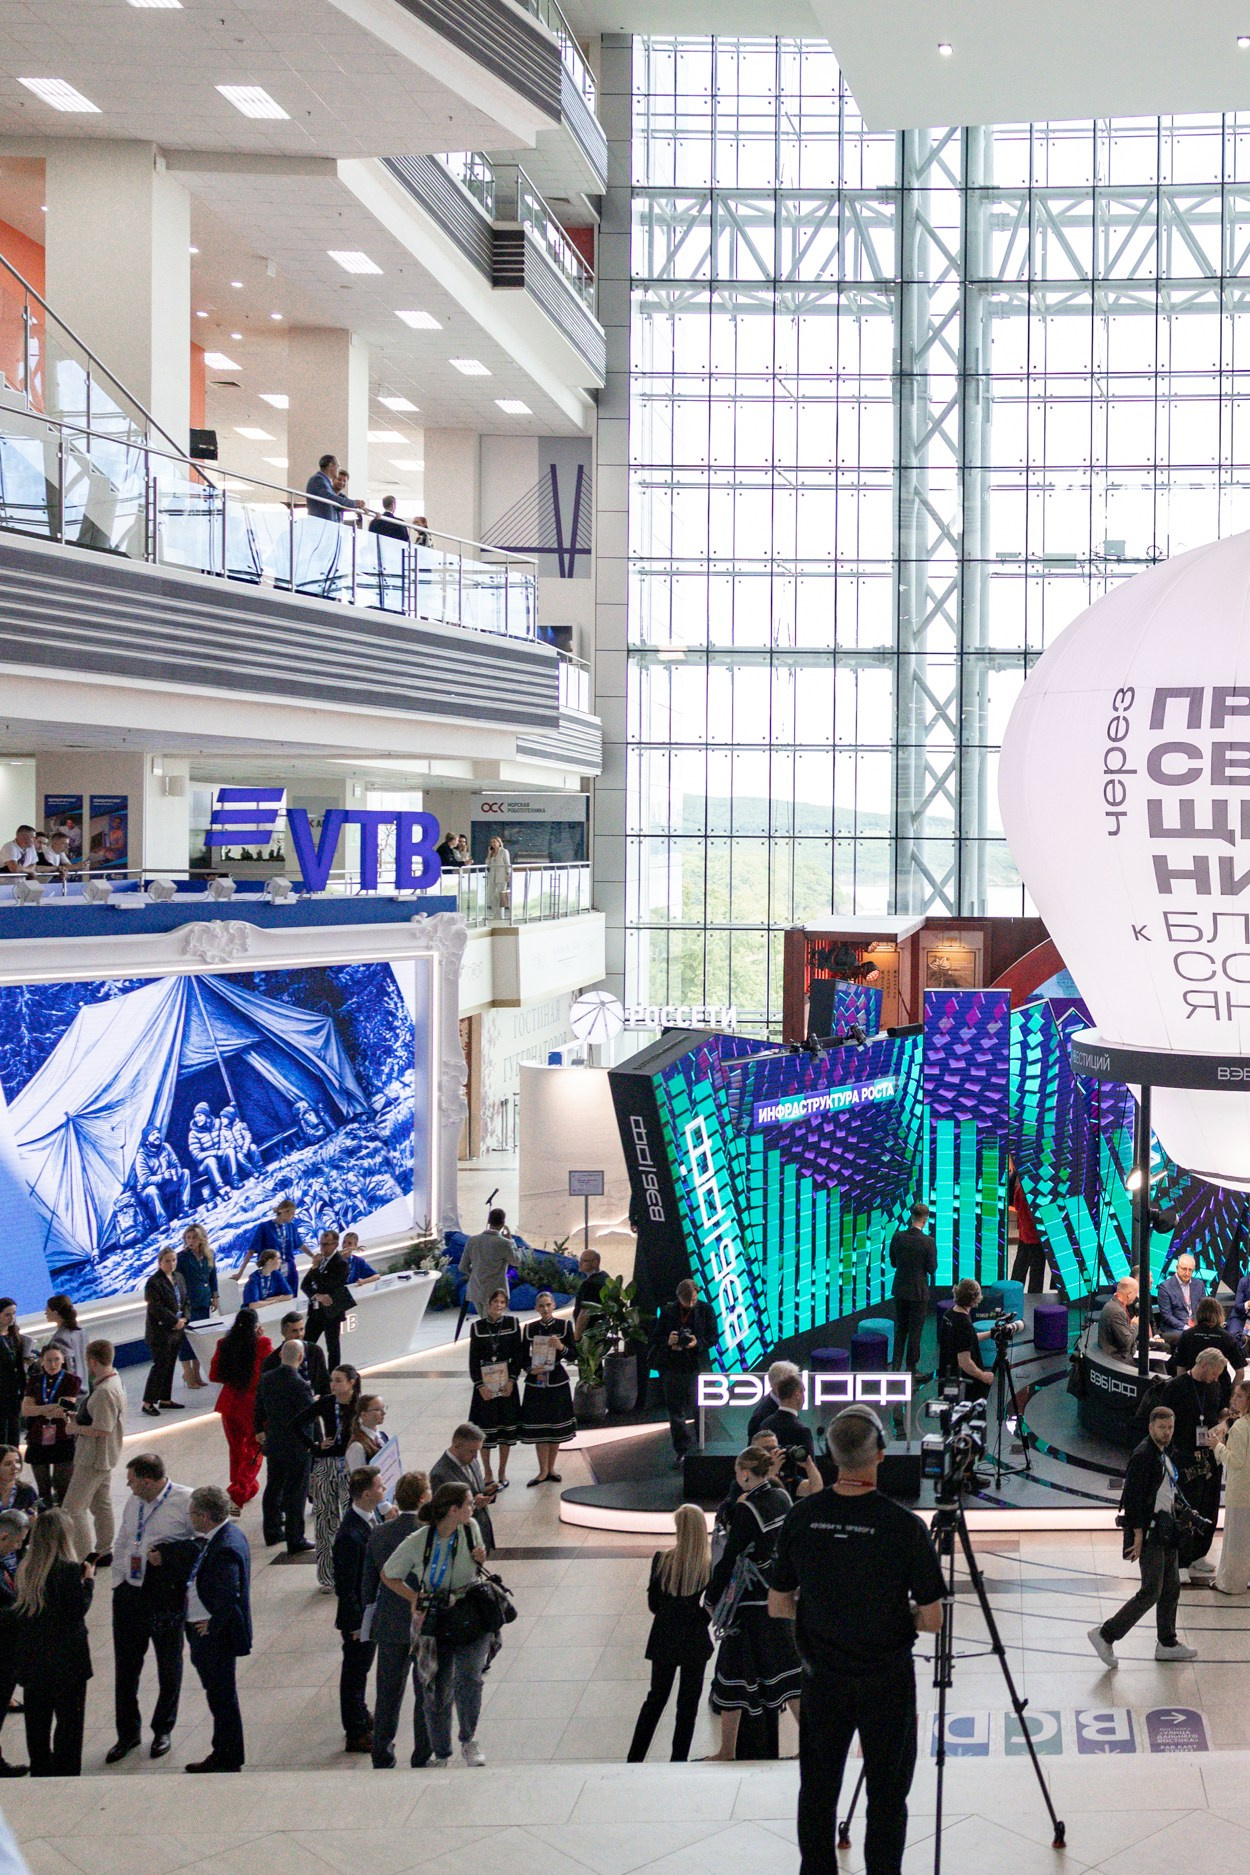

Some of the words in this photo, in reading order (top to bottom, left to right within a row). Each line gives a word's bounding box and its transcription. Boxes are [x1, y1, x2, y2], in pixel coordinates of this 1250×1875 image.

[1104, 687, 1137, 836] через
[481, 802, 504, 813] ОСК
[286, 808, 441, 891] VTB
[1131, 924, 1151, 941] к
[513, 999, 560, 1039] ГОСТИНАЯ
[629, 1006, 737, 1029] РОССЕТИ
[1073, 1050, 1110, 1071] ВЕСТИЦИЙ
[758, 1088, 859, 1123] ИНФРАСТРУКТУРА
[861, 1082, 895, 1102] РОСТА
[630, 1116, 665, 1222] ВЭБ|РФ
[685, 1115, 750, 1349] ВЭБ|РФ
[698, 1370, 912, 1410] ВЭ|РФ
[1090, 1370, 1137, 1397] ВЭБ|РФ
[1078, 1709, 1131, 1741] B
